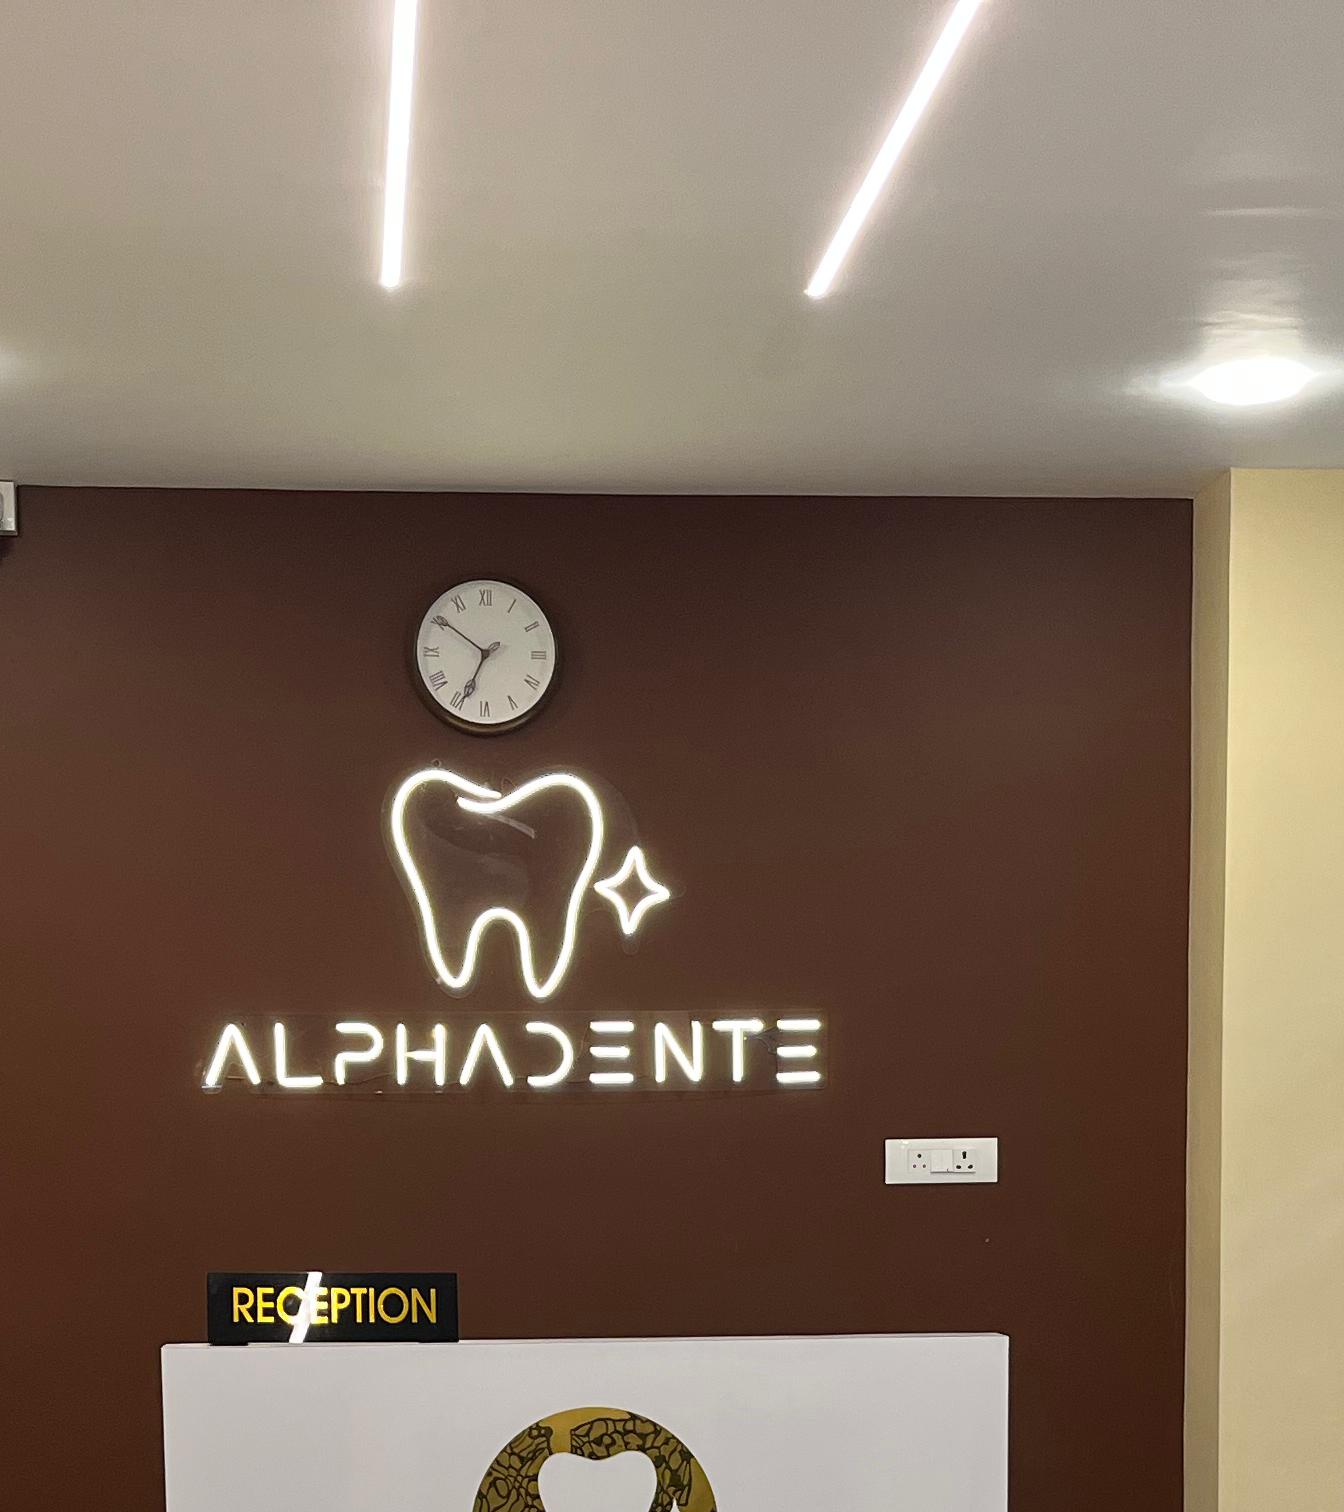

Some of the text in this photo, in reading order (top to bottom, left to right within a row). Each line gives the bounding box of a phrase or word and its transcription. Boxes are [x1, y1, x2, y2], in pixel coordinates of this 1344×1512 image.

[478, 589, 492, 606] XII
[204, 1019, 822, 1088] ALPHADENTE
[232, 1286, 436, 1325] RECEPTION
